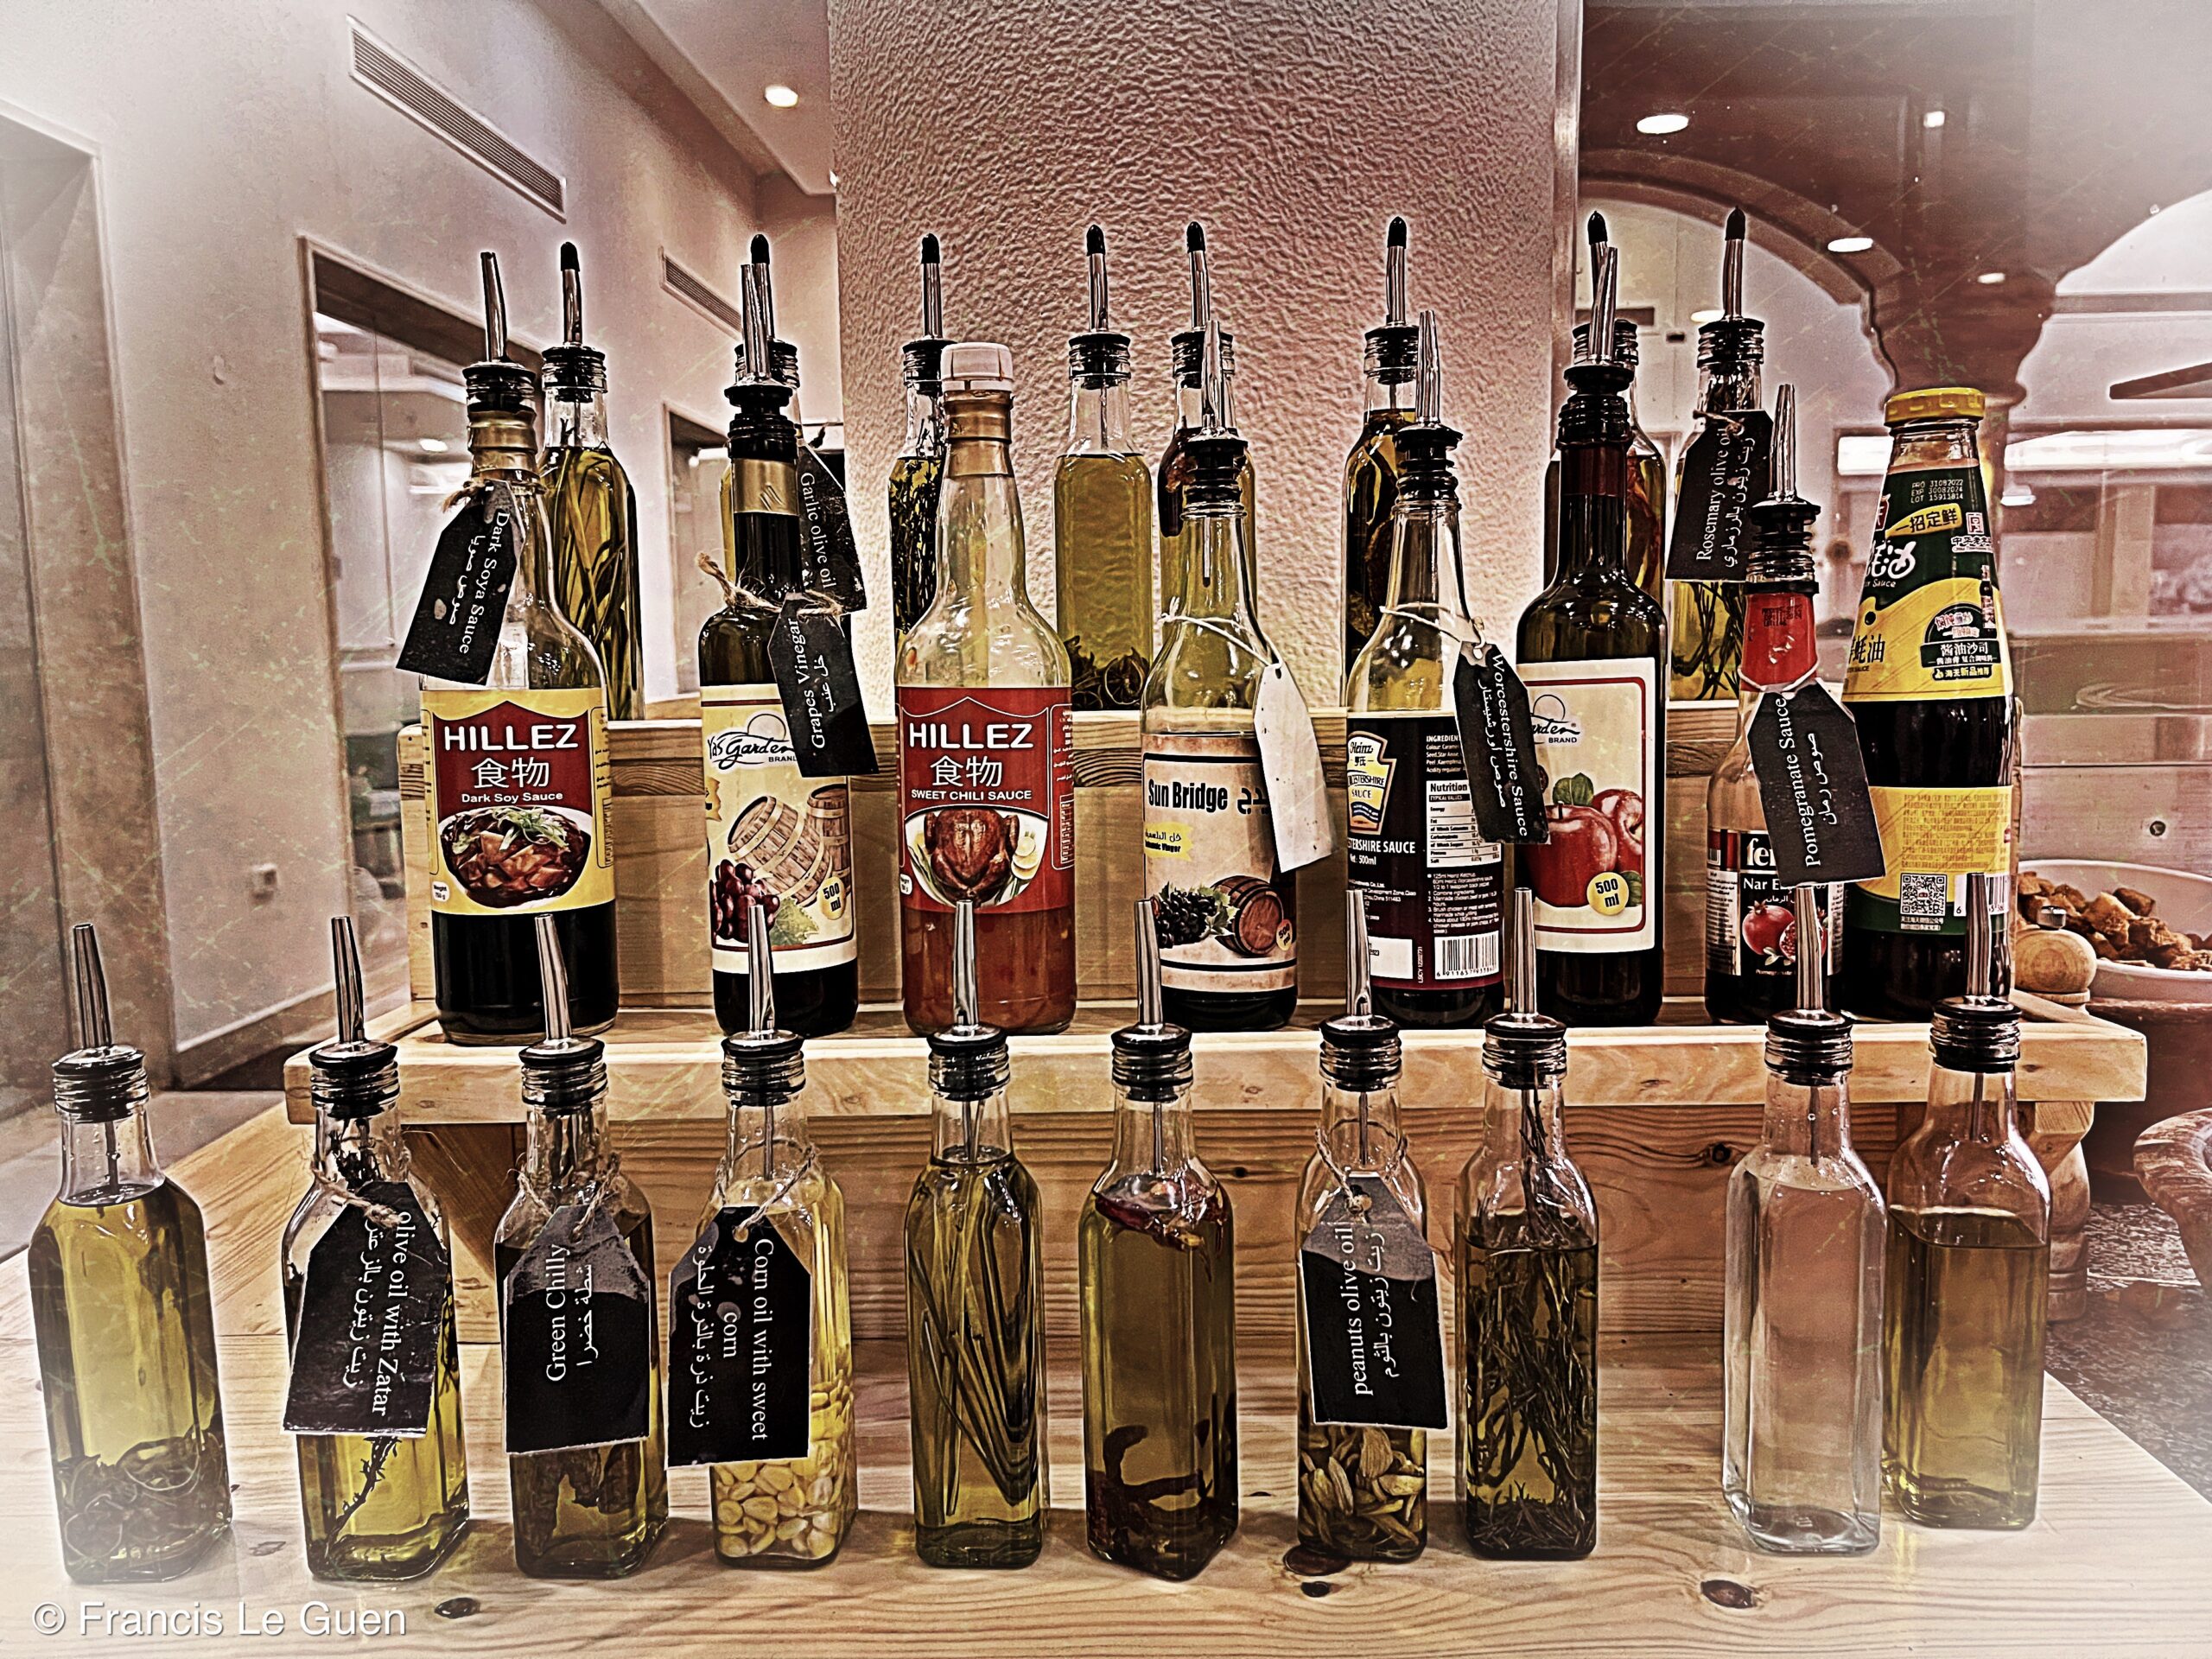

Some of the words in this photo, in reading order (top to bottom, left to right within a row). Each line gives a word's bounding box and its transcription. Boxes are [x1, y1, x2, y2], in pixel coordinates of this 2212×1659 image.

[1710, 450, 1728, 486] olive
[1738, 437, 1756, 464] زيت
[1910, 495, 1924, 504] LOT
[486, 512, 510, 553] Dark
[800, 472, 818, 521] Garlic
[810, 524, 828, 563] olive
[820, 568, 836, 589] oil
[1696, 491, 1725, 561] Rosemary
[1895, 508, 1958, 533] 一招定鲜
[448, 575, 468, 626] صوص
[467, 535, 486, 572] صويا
[474, 557, 498, 601] Soya
[1872, 579, 1897, 588] Sauce
[459, 604, 485, 655] Sauce
[791, 617, 811, 685] Vinegar
[816, 654, 830, 678] خل
[1941, 642, 1988, 657] 酱油沙司
[810, 689, 826, 749] Grapes
[820, 686, 836, 713] عنب
[444, 724, 579, 752] HILLEZ
[909, 723, 1034, 749] HILLEZ
[1775, 697, 1796, 749] Sauce
[719, 737, 796, 770] Garden
[1349, 741, 1374, 754] Heinz
[1491, 653, 1518, 781] Worcestershire
[1511, 785, 1528, 837] Sauce
[1808, 733, 1829, 785] صوص
[470, 756, 550, 789] 食物
[930, 755, 1003, 787] 食物
[1430, 783, 1468, 792] Nutrition
[1490, 755, 1506, 809] صوص
[461, 792, 491, 804] Dark
[494, 793, 518, 804] Soy
[522, 791, 563, 802] Sauce
[911, 789, 947, 800] SWEET
[949, 791, 984, 801] CHILI
[988, 790, 1033, 800] SAUCE
[1148, 779, 1169, 807] Sun
[1173, 781, 1228, 813] Bridge
[1351, 790, 1372, 799] SAUCE
[1783, 754, 1822, 868] Pomegranate
[1818, 789, 1838, 825] رمان
[1359, 855, 1376, 866] 500ml
[1383, 841, 1416, 854] SAUCE
[823, 882, 841, 900] 500
[1595, 878, 1618, 894] 500
[1605, 893, 1620, 908] ml
[1743, 878, 1768, 890] Nar
[830, 899, 842, 912] ml
[1279, 923, 1290, 939] 500
[391, 1211, 416, 1263] olive
[1334, 1226, 1355, 1253] oil
[1365, 1232, 1386, 1273] زيت
[388, 1272, 408, 1298] oil
[546, 1244, 570, 1309] Chilly
[575, 1264, 593, 1306] شطة
[692, 1245, 715, 1295] الحلوة
[753, 1238, 774, 1293] Corn
[1340, 1259, 1361, 1312] olive
[1370, 1277, 1392, 1327] زيتون
[349, 1288, 374, 1341] زيتون
[380, 1305, 405, 1351] with
[691, 1300, 715, 1350] بالذرة
[753, 1300, 773, 1325] oil
[546, 1314, 566, 1382] Green
[723, 1311, 739, 1358] corn
[753, 1329, 773, 1376] with
[342, 1346, 367, 1389] زيت
[690, 1353, 714, 1384] ذرة
[1344, 1317, 1374, 1396] peanuts
[1374, 1332, 1400, 1378] بالثوم
[372, 1357, 399, 1417] Zatar
[690, 1389, 710, 1428] زيت
[752, 1382, 768, 1441] sweet
